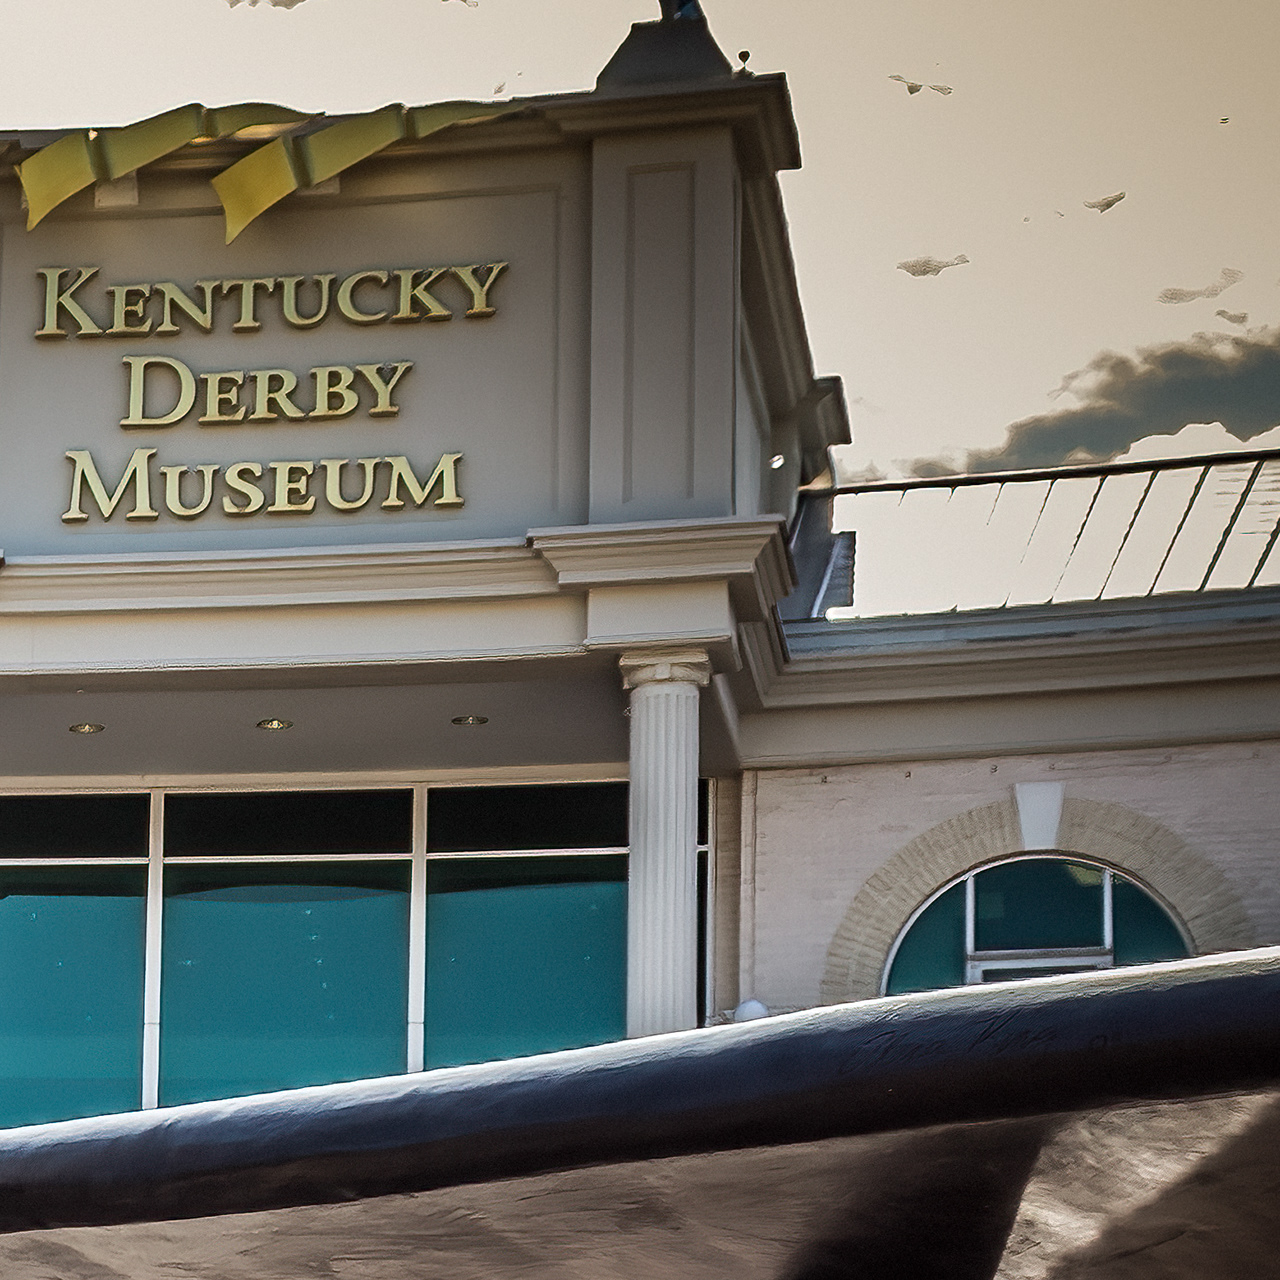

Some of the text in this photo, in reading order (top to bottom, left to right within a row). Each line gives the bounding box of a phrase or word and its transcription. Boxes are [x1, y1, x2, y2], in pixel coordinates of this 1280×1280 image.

[34, 260, 510, 339] KENTUCKY
[120, 354, 414, 430] DERBY
[60, 447, 466, 522] MUSEUM
